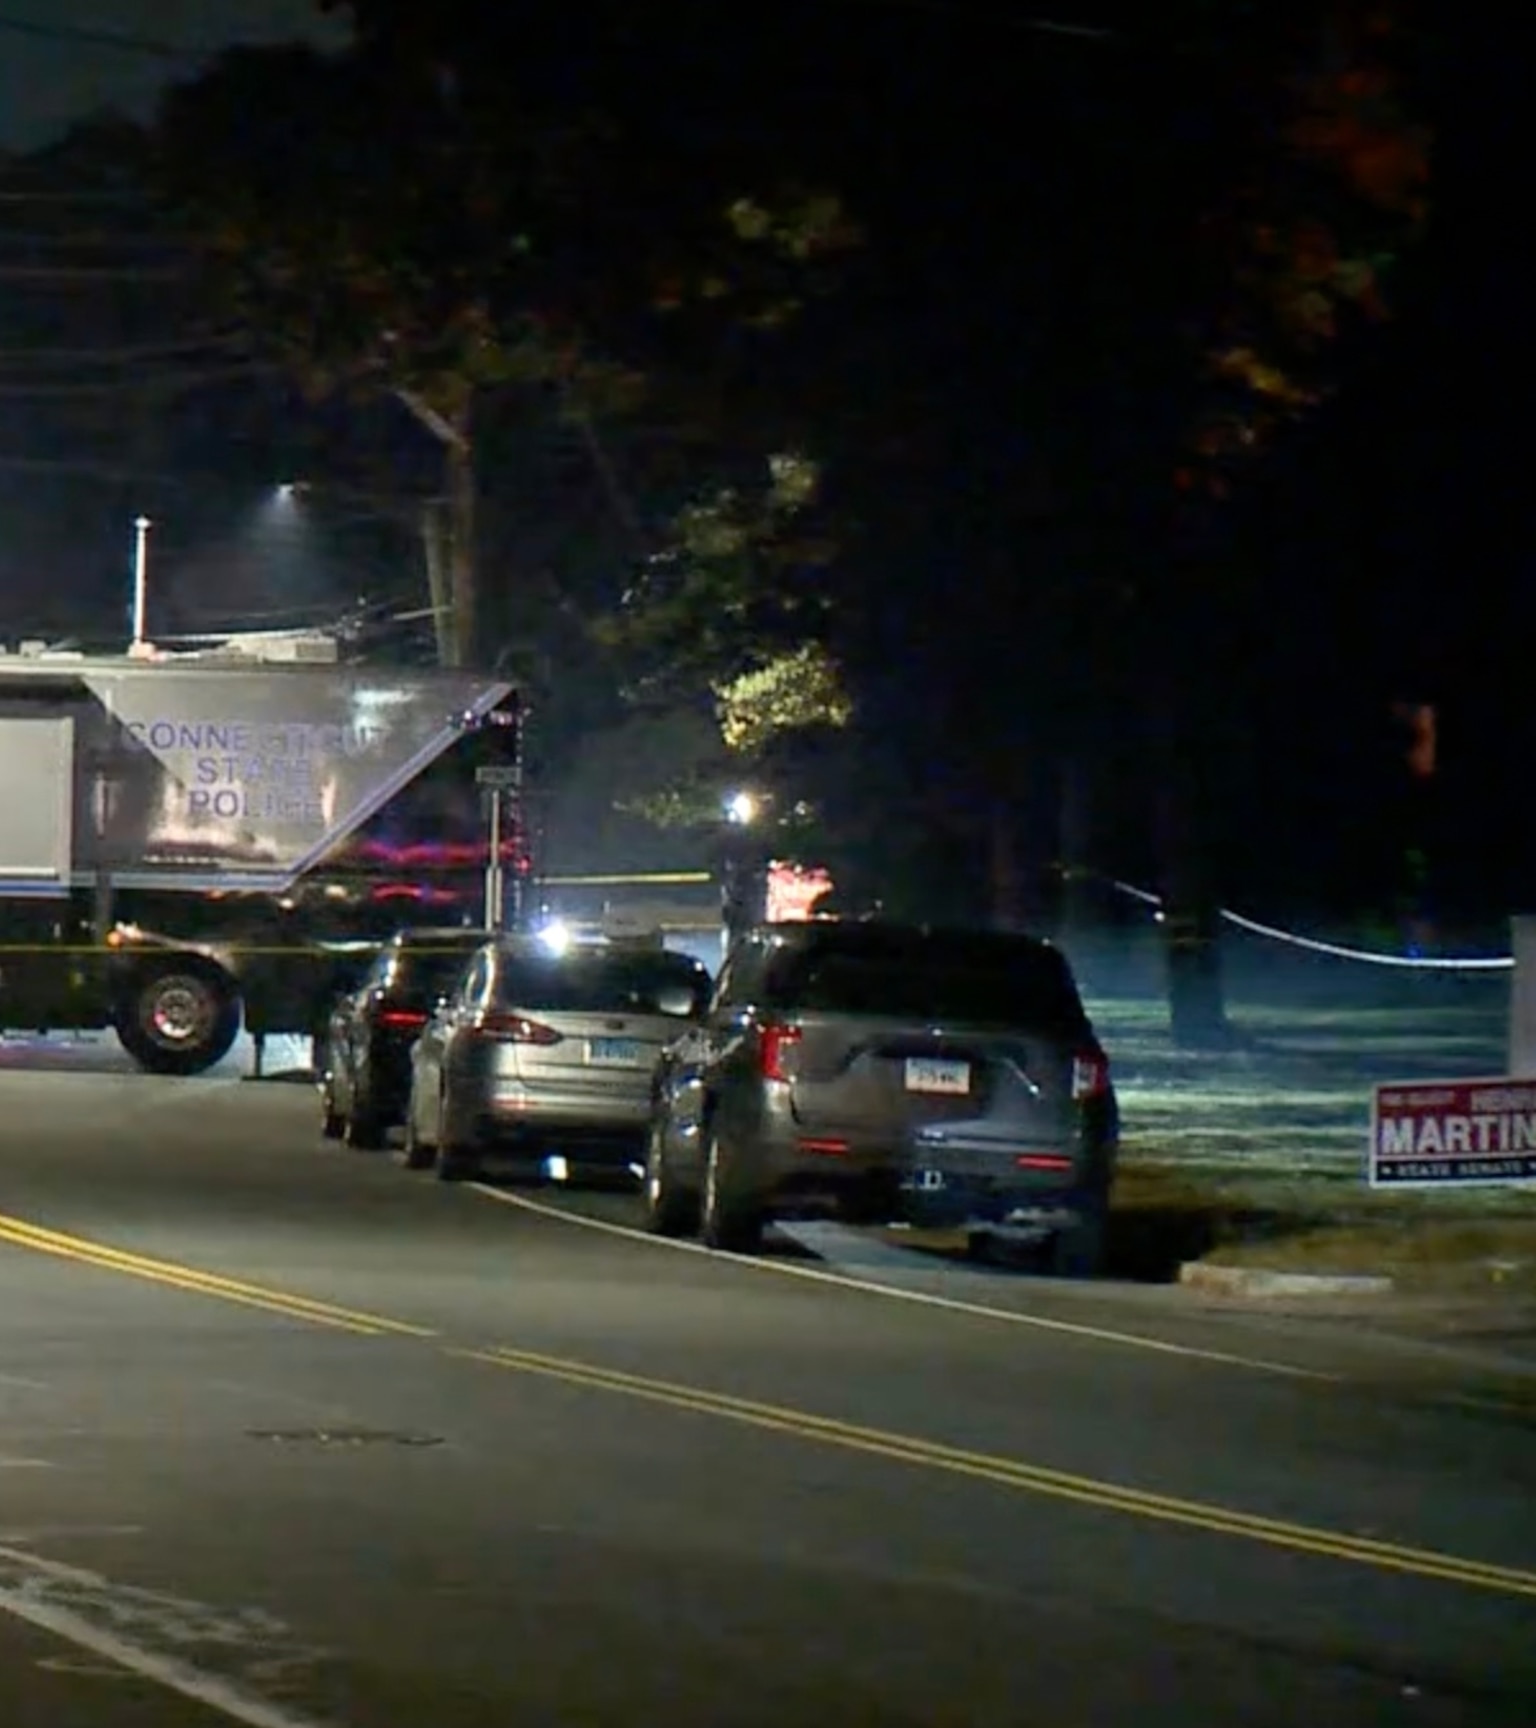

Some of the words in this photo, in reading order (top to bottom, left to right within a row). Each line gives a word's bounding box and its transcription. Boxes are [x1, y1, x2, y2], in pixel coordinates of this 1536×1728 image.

[197, 756, 311, 785] STATE
[188, 789, 321, 822] POLICE
[1381, 1113, 1536, 1155] MARTIN
